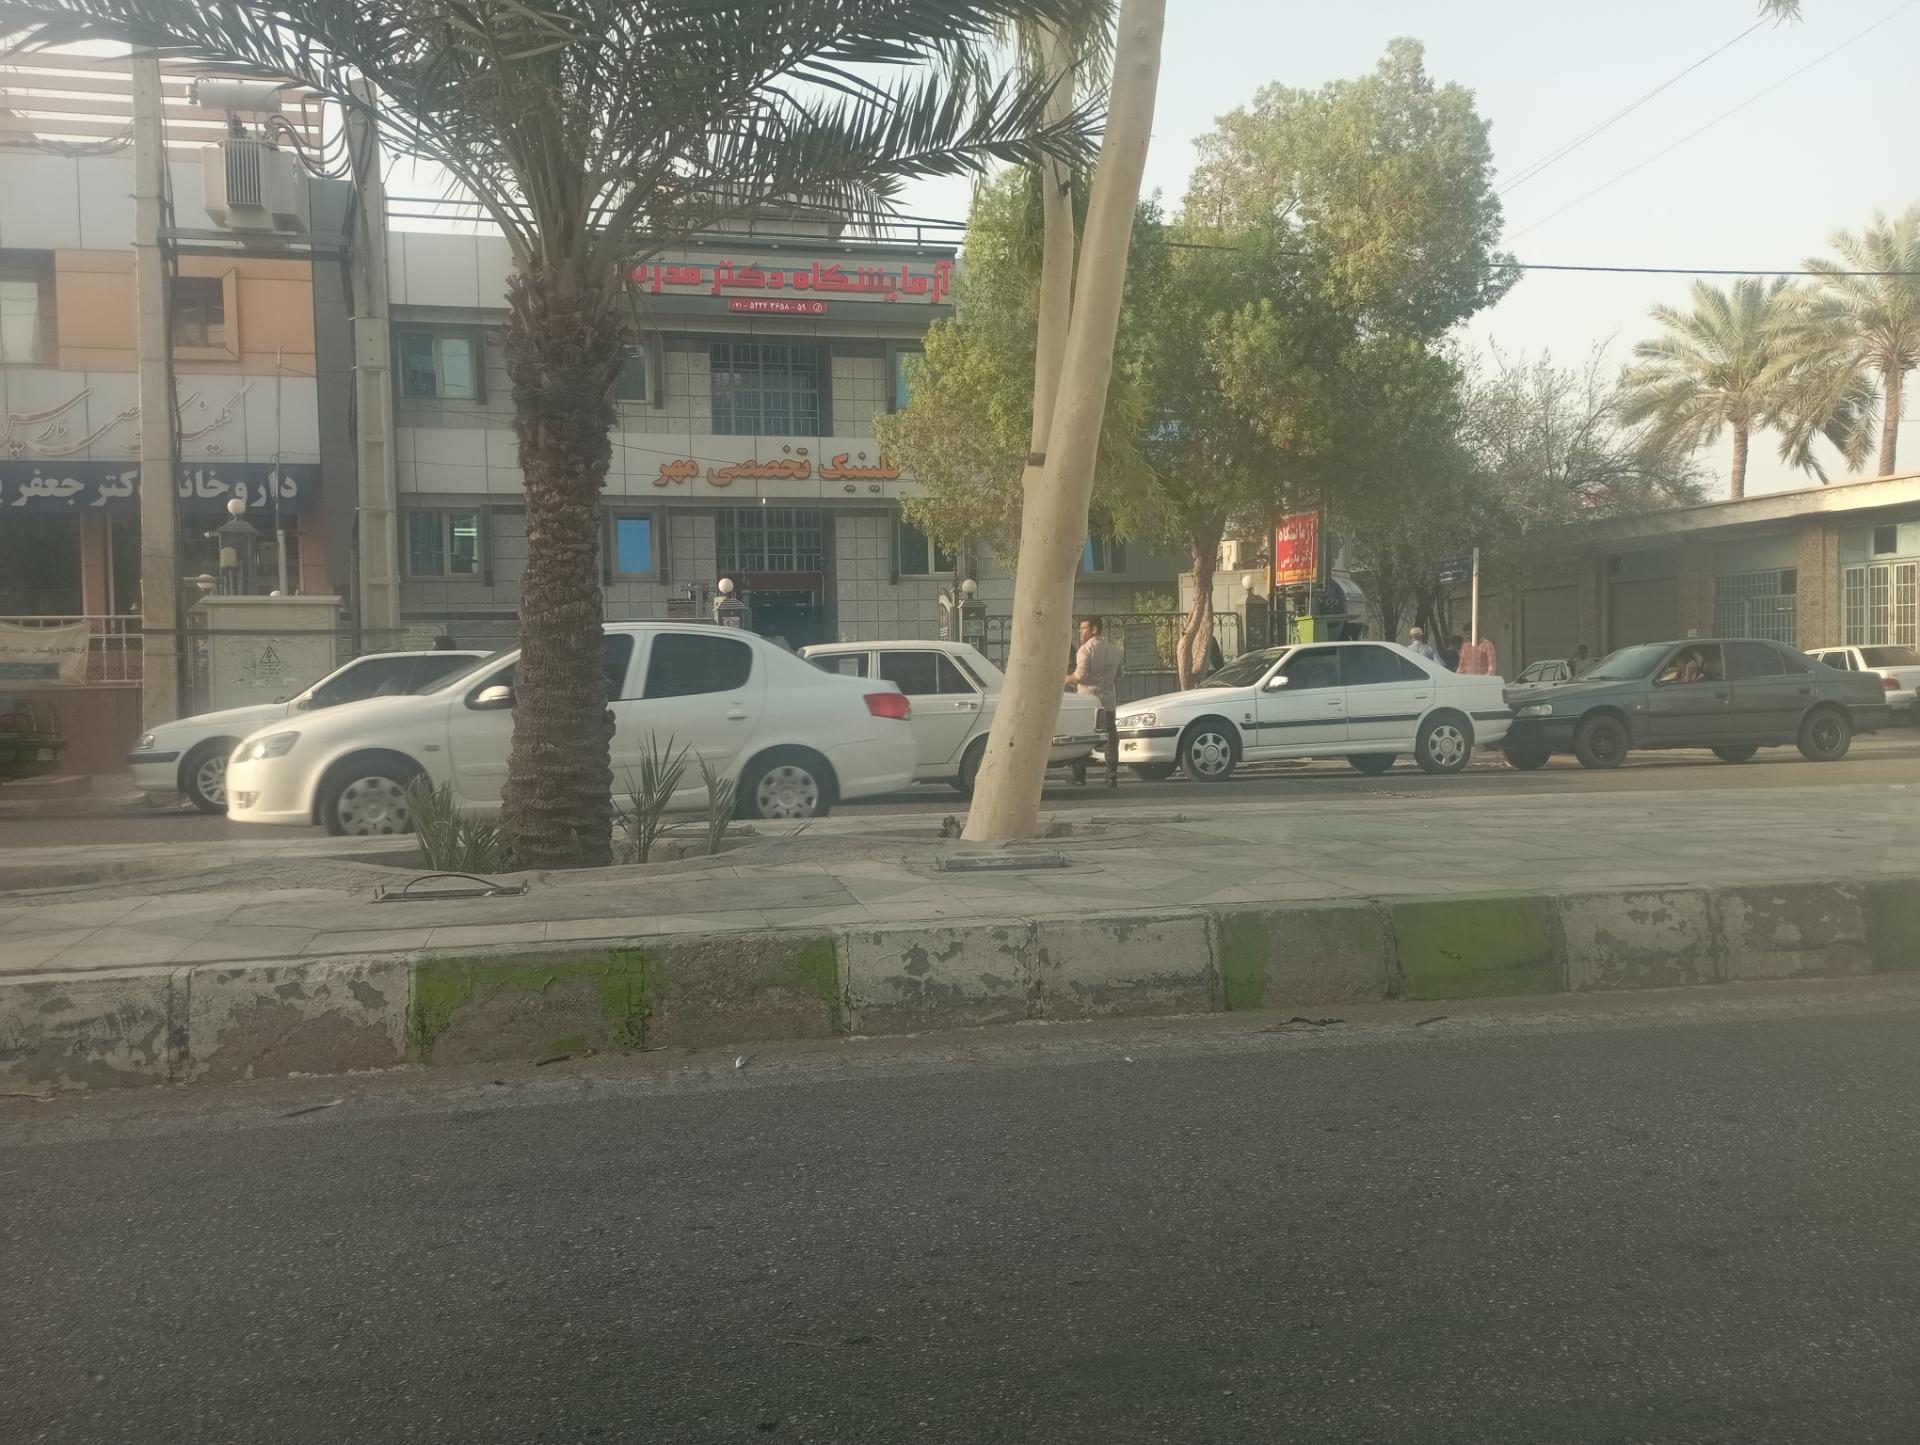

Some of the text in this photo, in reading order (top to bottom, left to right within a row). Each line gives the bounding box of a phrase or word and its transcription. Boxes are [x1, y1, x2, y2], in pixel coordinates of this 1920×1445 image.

[631, 259, 952, 303] آزمایشگاه دکتر مدرس
[653, 459, 699, 487] مهر
[707, 444, 812, 488] تخصصی
[11, 467, 86, 507] جعفر
[90, 469, 140, 507] کتر
[178, 469, 298, 507] داروخان
